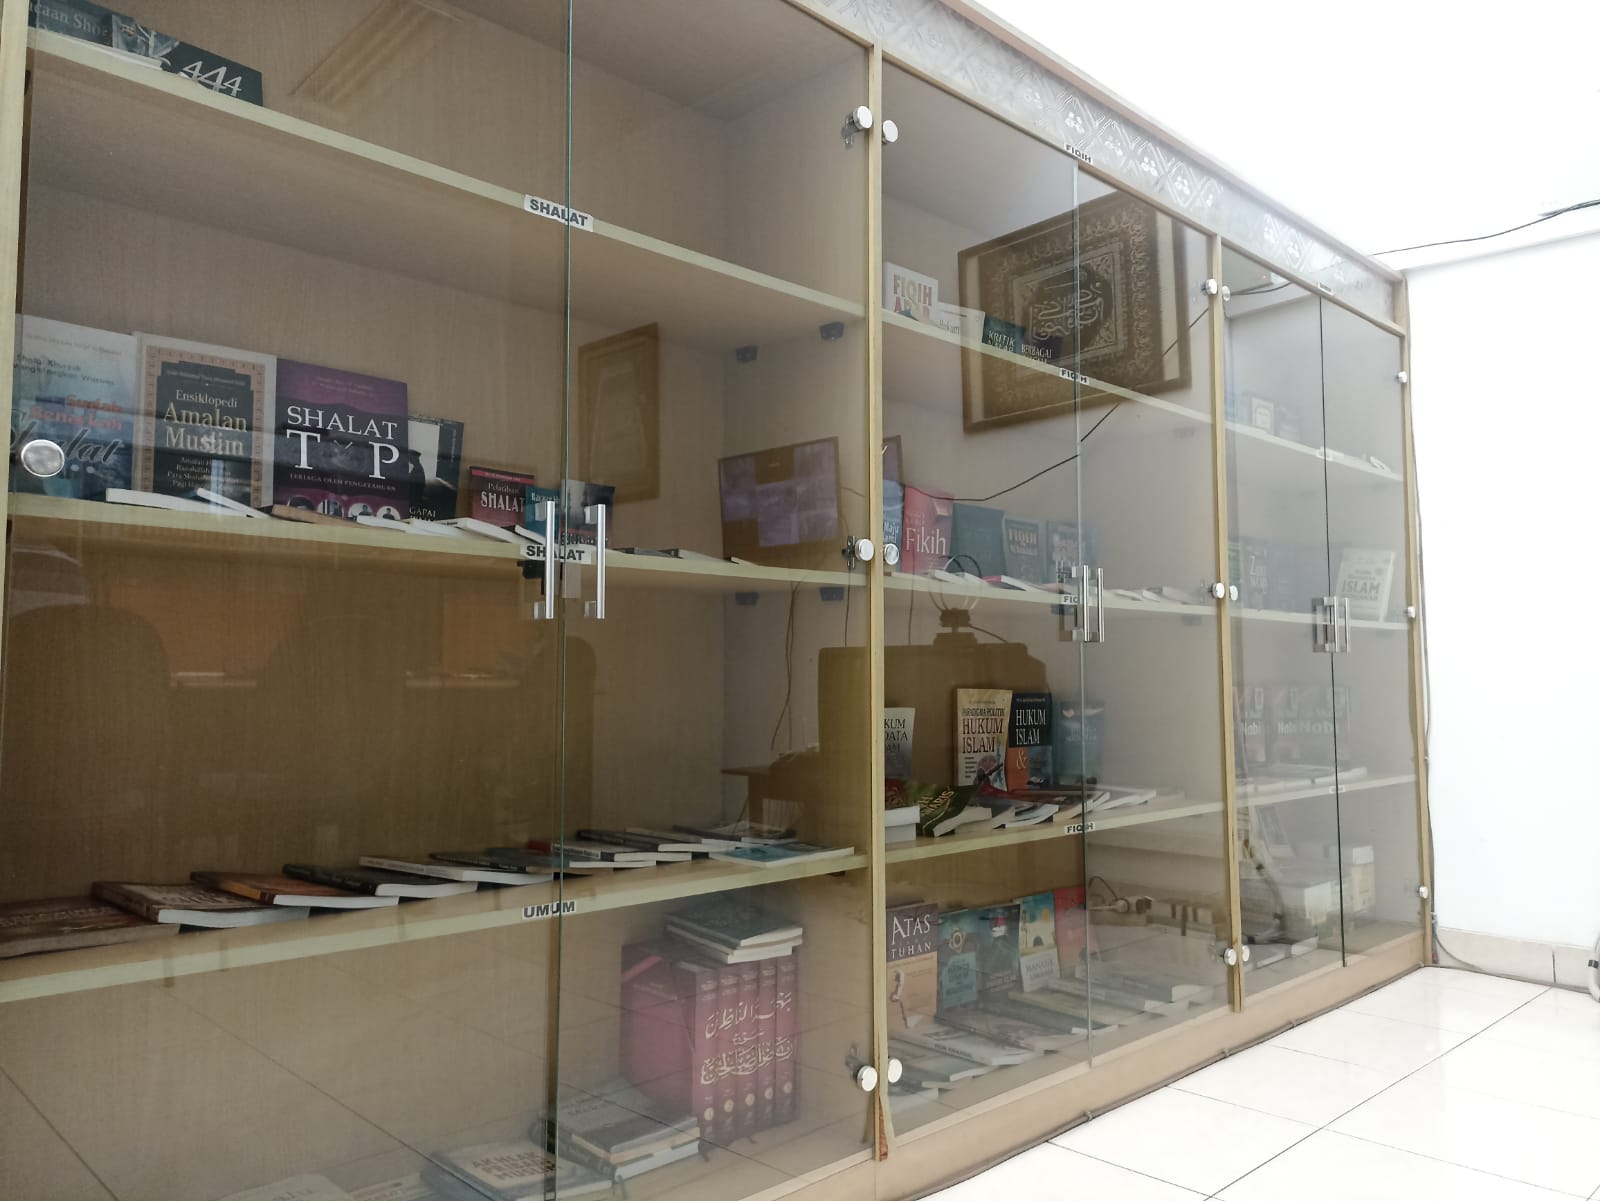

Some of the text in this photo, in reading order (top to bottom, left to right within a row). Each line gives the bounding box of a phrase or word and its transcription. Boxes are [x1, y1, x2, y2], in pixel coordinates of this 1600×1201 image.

[1065, 143, 1091, 163] FIQIH
[529, 198, 588, 227] SHALAT
[175, 389, 238, 409] Ensiklopedi
[163, 401, 248, 433] Amalan
[286, 405, 398, 440] SHALAT
[164, 426, 245, 456] Muslim
[480, 491, 525, 513] SHALAT
[906, 526, 947, 556] Fikih
[962, 717, 1004, 735] HUKUM
[1015, 709, 1046, 726] HUKUM
[962, 736, 995, 754] ISLAM
[1015, 728, 1040, 745] ISLAM
[523, 900, 576, 918] UMUM
[890, 913, 931, 945] ATAS
[889, 941, 932, 960] TUHAN
